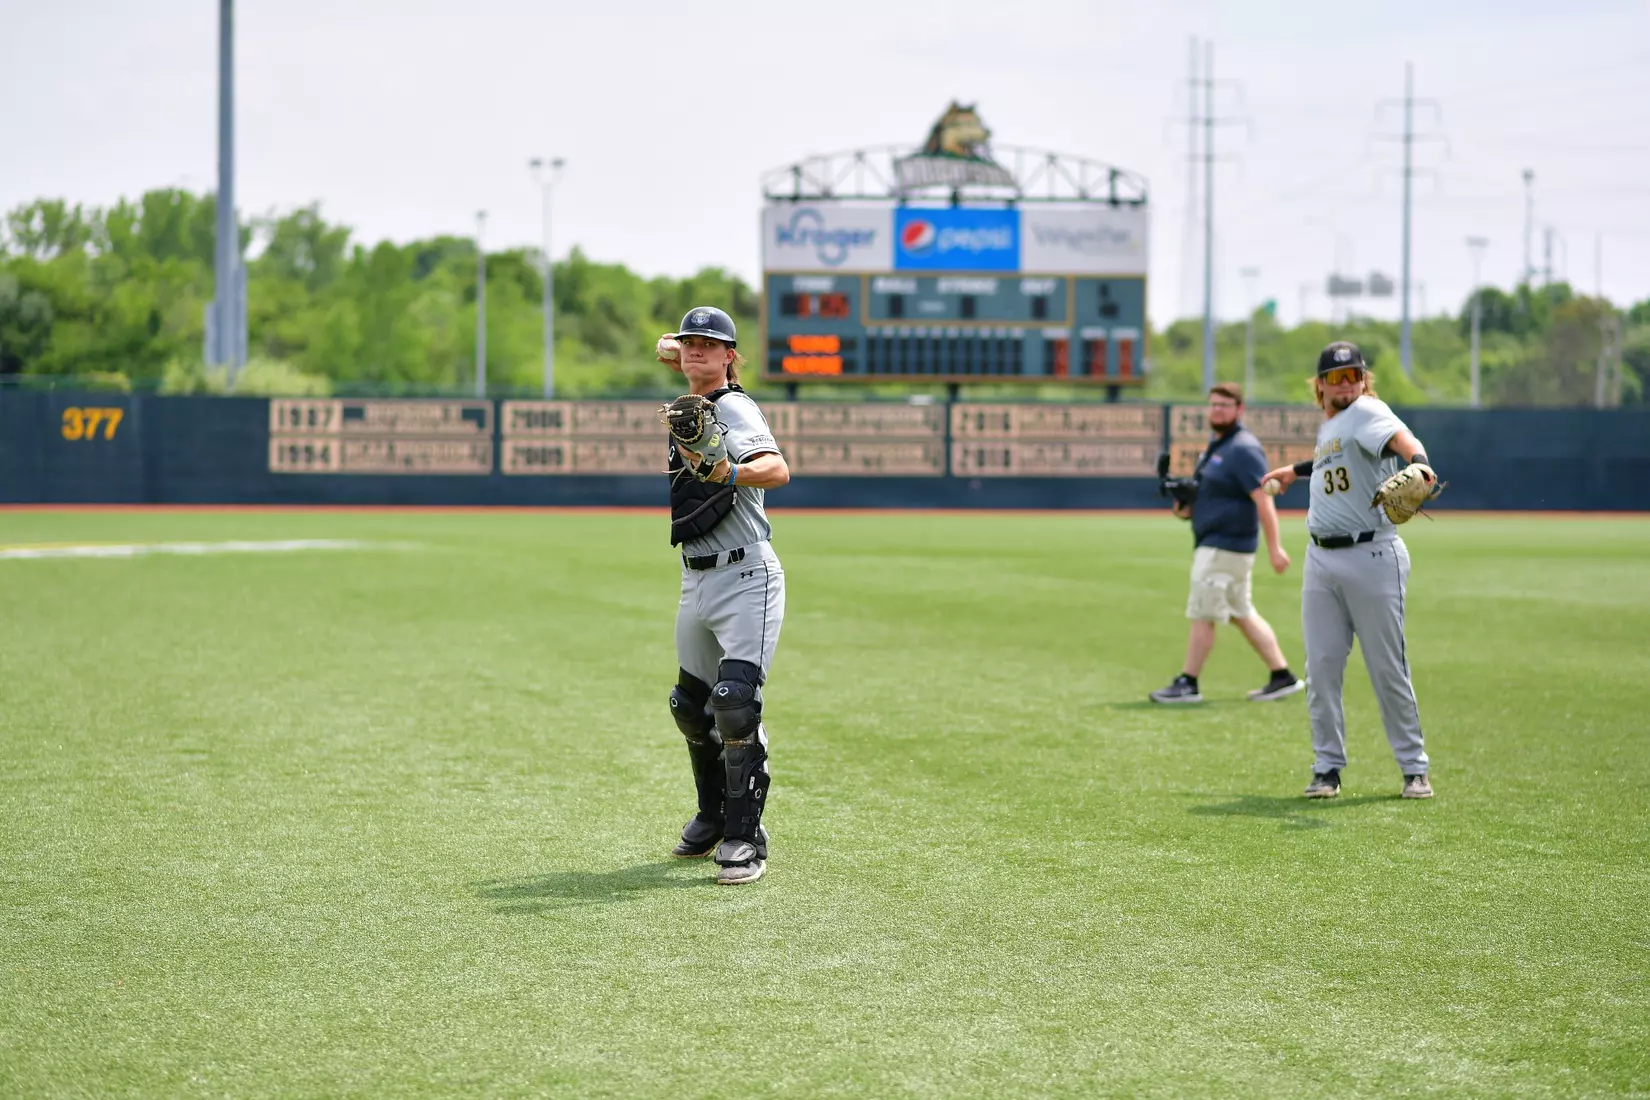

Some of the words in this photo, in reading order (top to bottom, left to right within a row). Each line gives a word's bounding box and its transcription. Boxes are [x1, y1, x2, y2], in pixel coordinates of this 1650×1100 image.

[775, 207, 878, 267] Kroger
[937, 225, 1013, 255] pepsi
[60, 406, 124, 441] 377
[1323, 466, 1351, 496] 33
